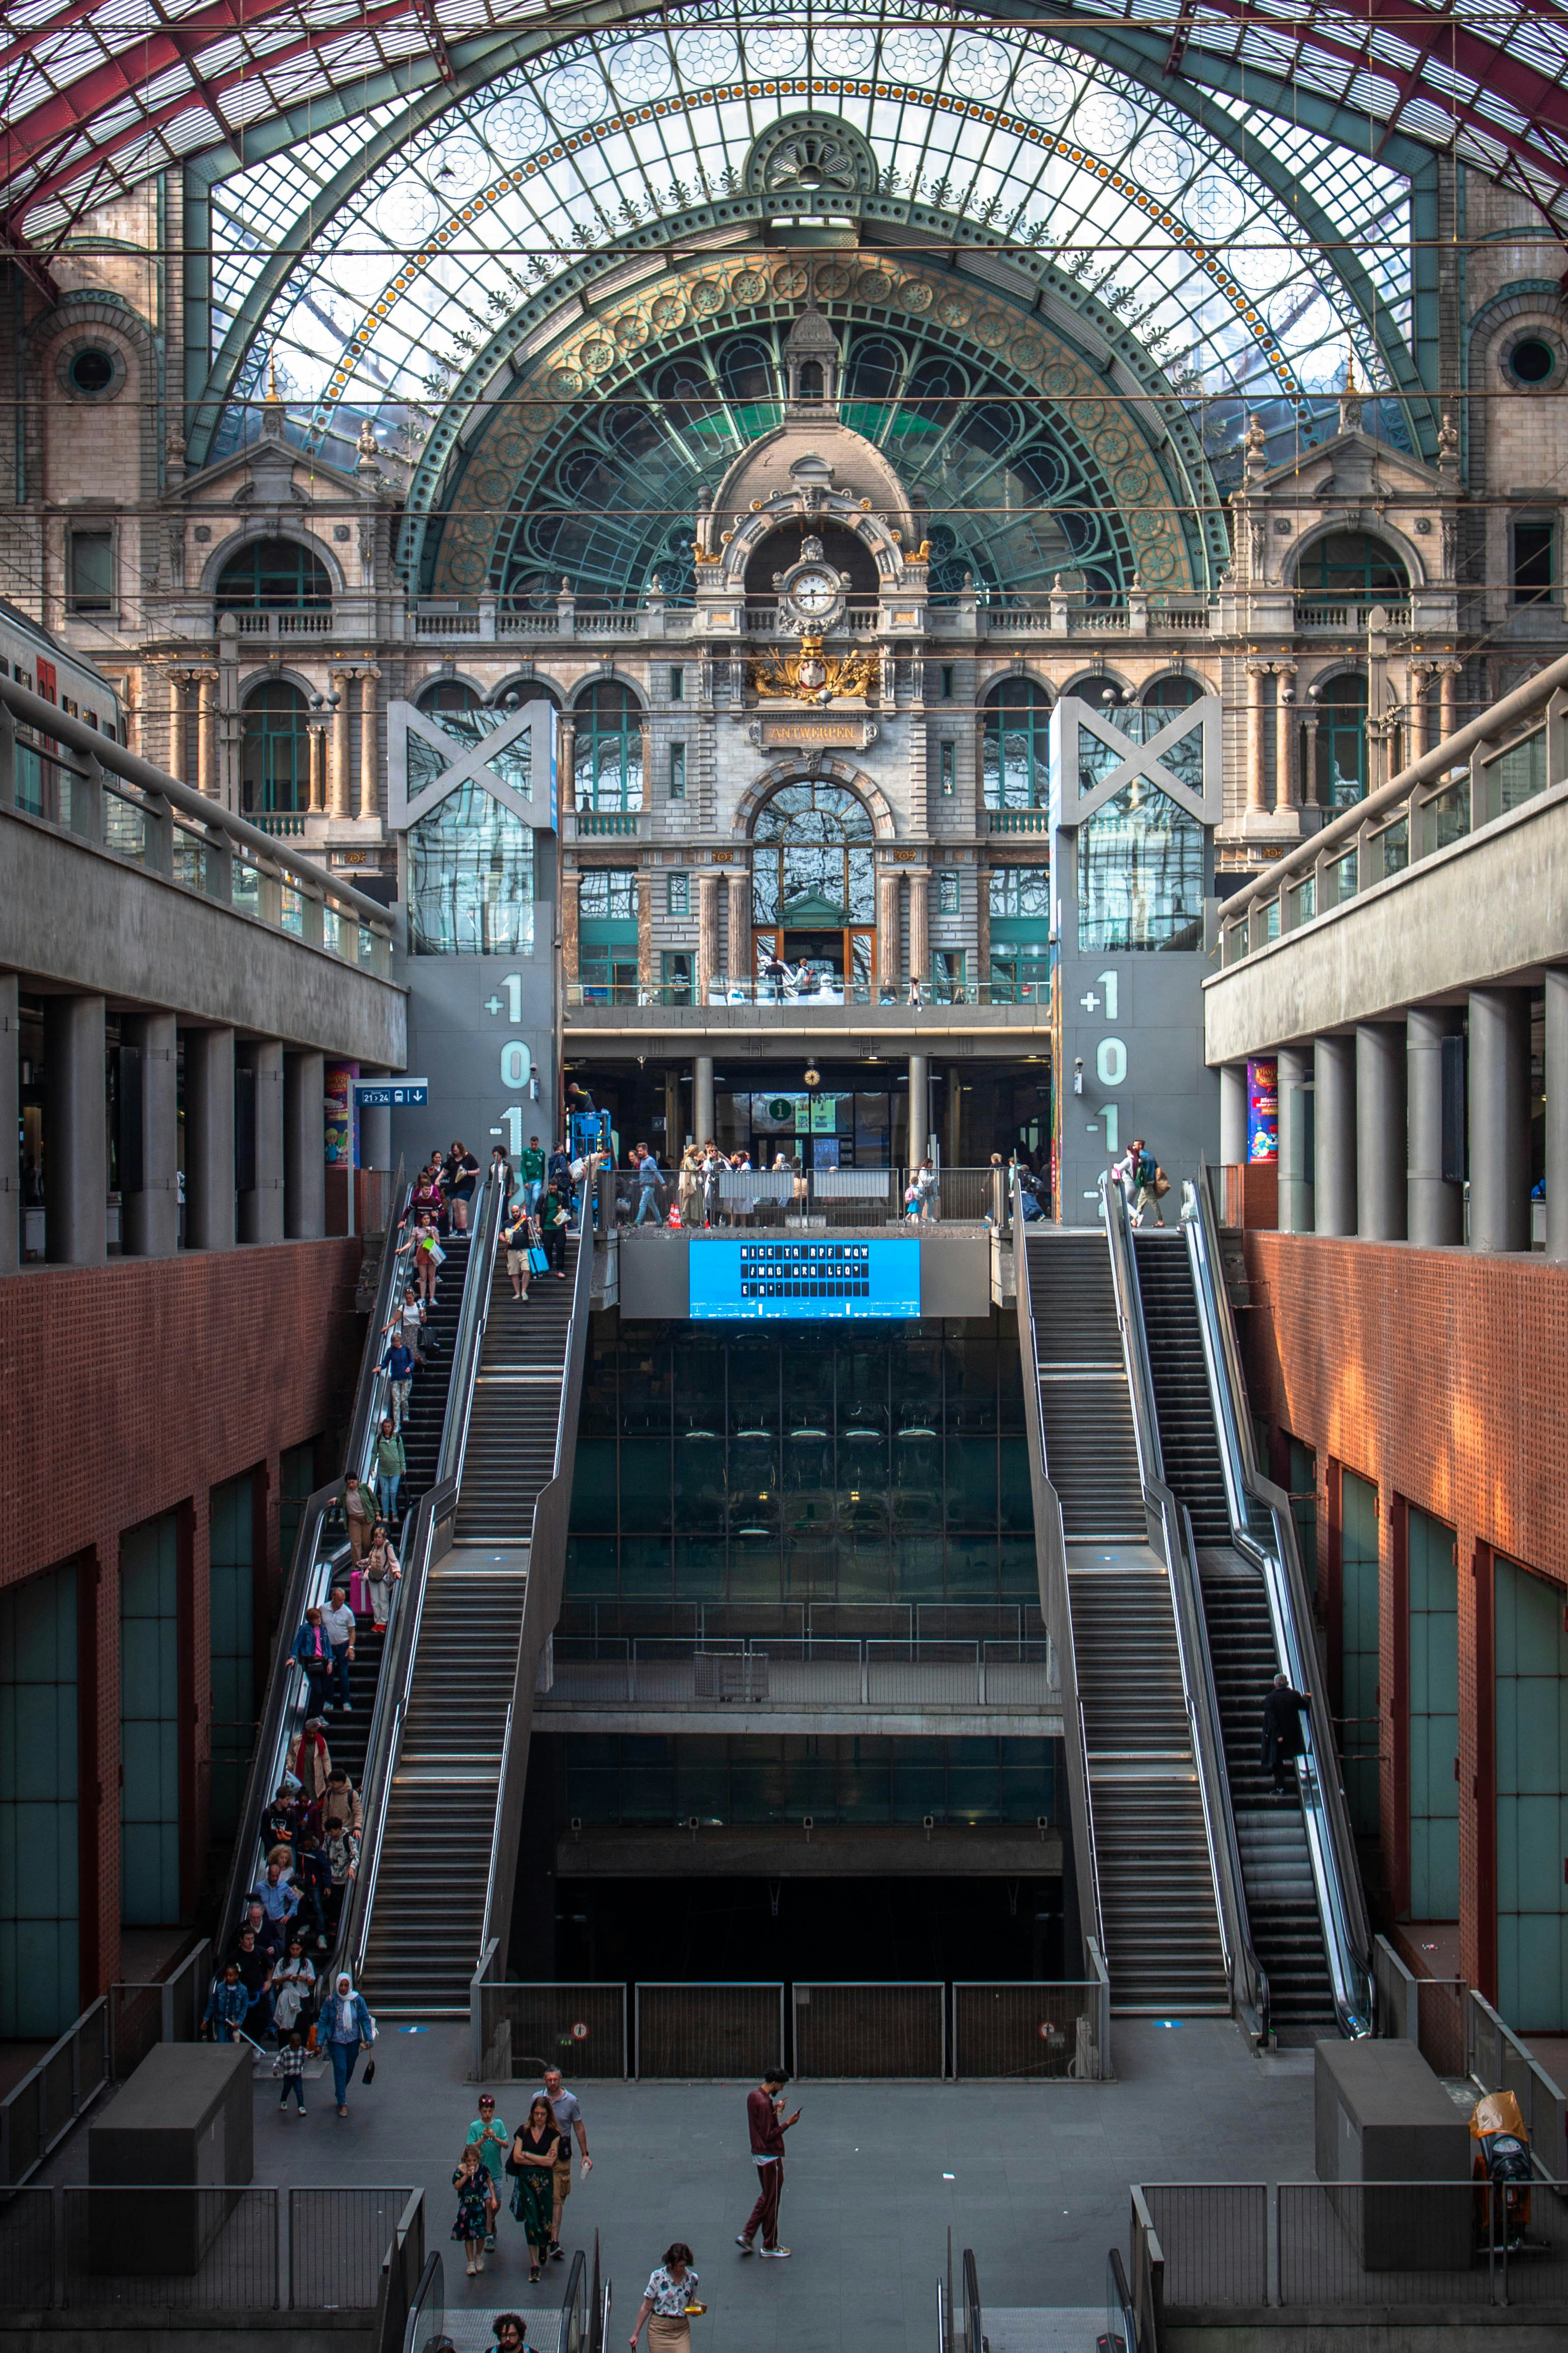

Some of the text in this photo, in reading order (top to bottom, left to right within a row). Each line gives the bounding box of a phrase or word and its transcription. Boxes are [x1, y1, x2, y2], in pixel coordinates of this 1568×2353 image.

[771, 726, 854, 738] ANTWERPEN
[484, 972, 522, 1023] +1
[1079, 969, 1118, 1019] +1
[500, 1040, 531, 1089] 0
[1096, 1036, 1128, 1086] 0
[489, 1106, 522, 1156] -1
[1085, 1103, 1119, 1153] -1
[742, 1248, 773, 1257] NICE
